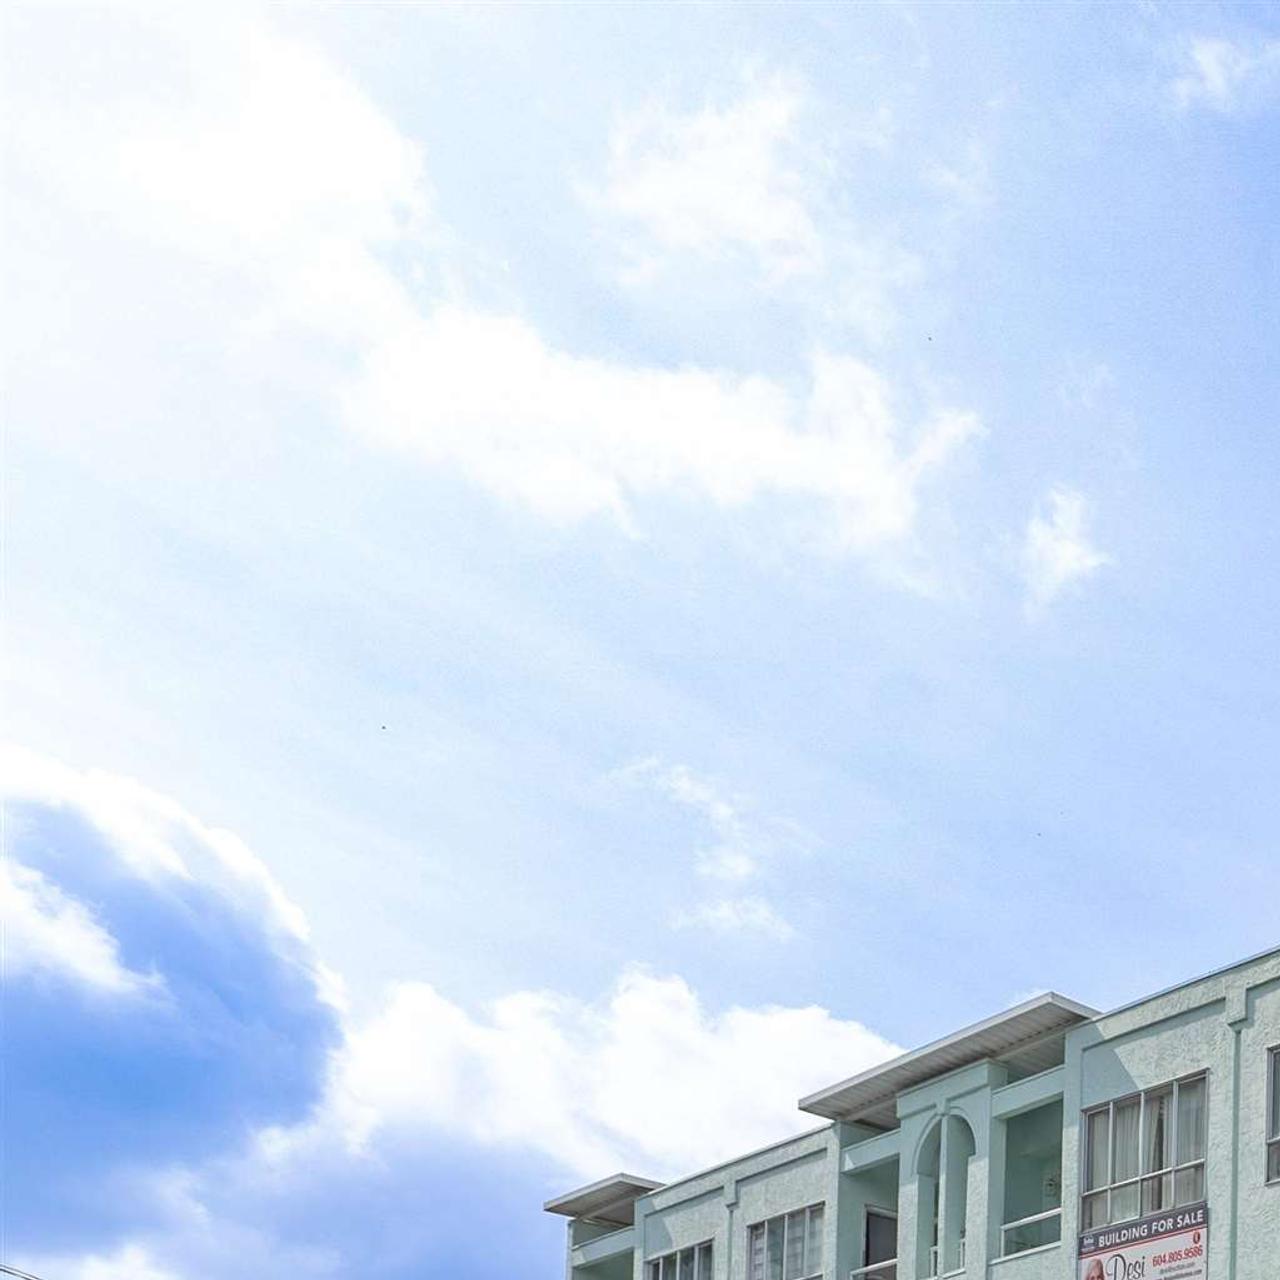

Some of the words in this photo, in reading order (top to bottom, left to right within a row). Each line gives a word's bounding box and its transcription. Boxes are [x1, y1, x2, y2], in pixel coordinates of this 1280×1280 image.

[1098, 1224, 1148, 1247] BUILDING
[1151, 1218, 1174, 1234] FOR
[1177, 1210, 1204, 1228] SALE
